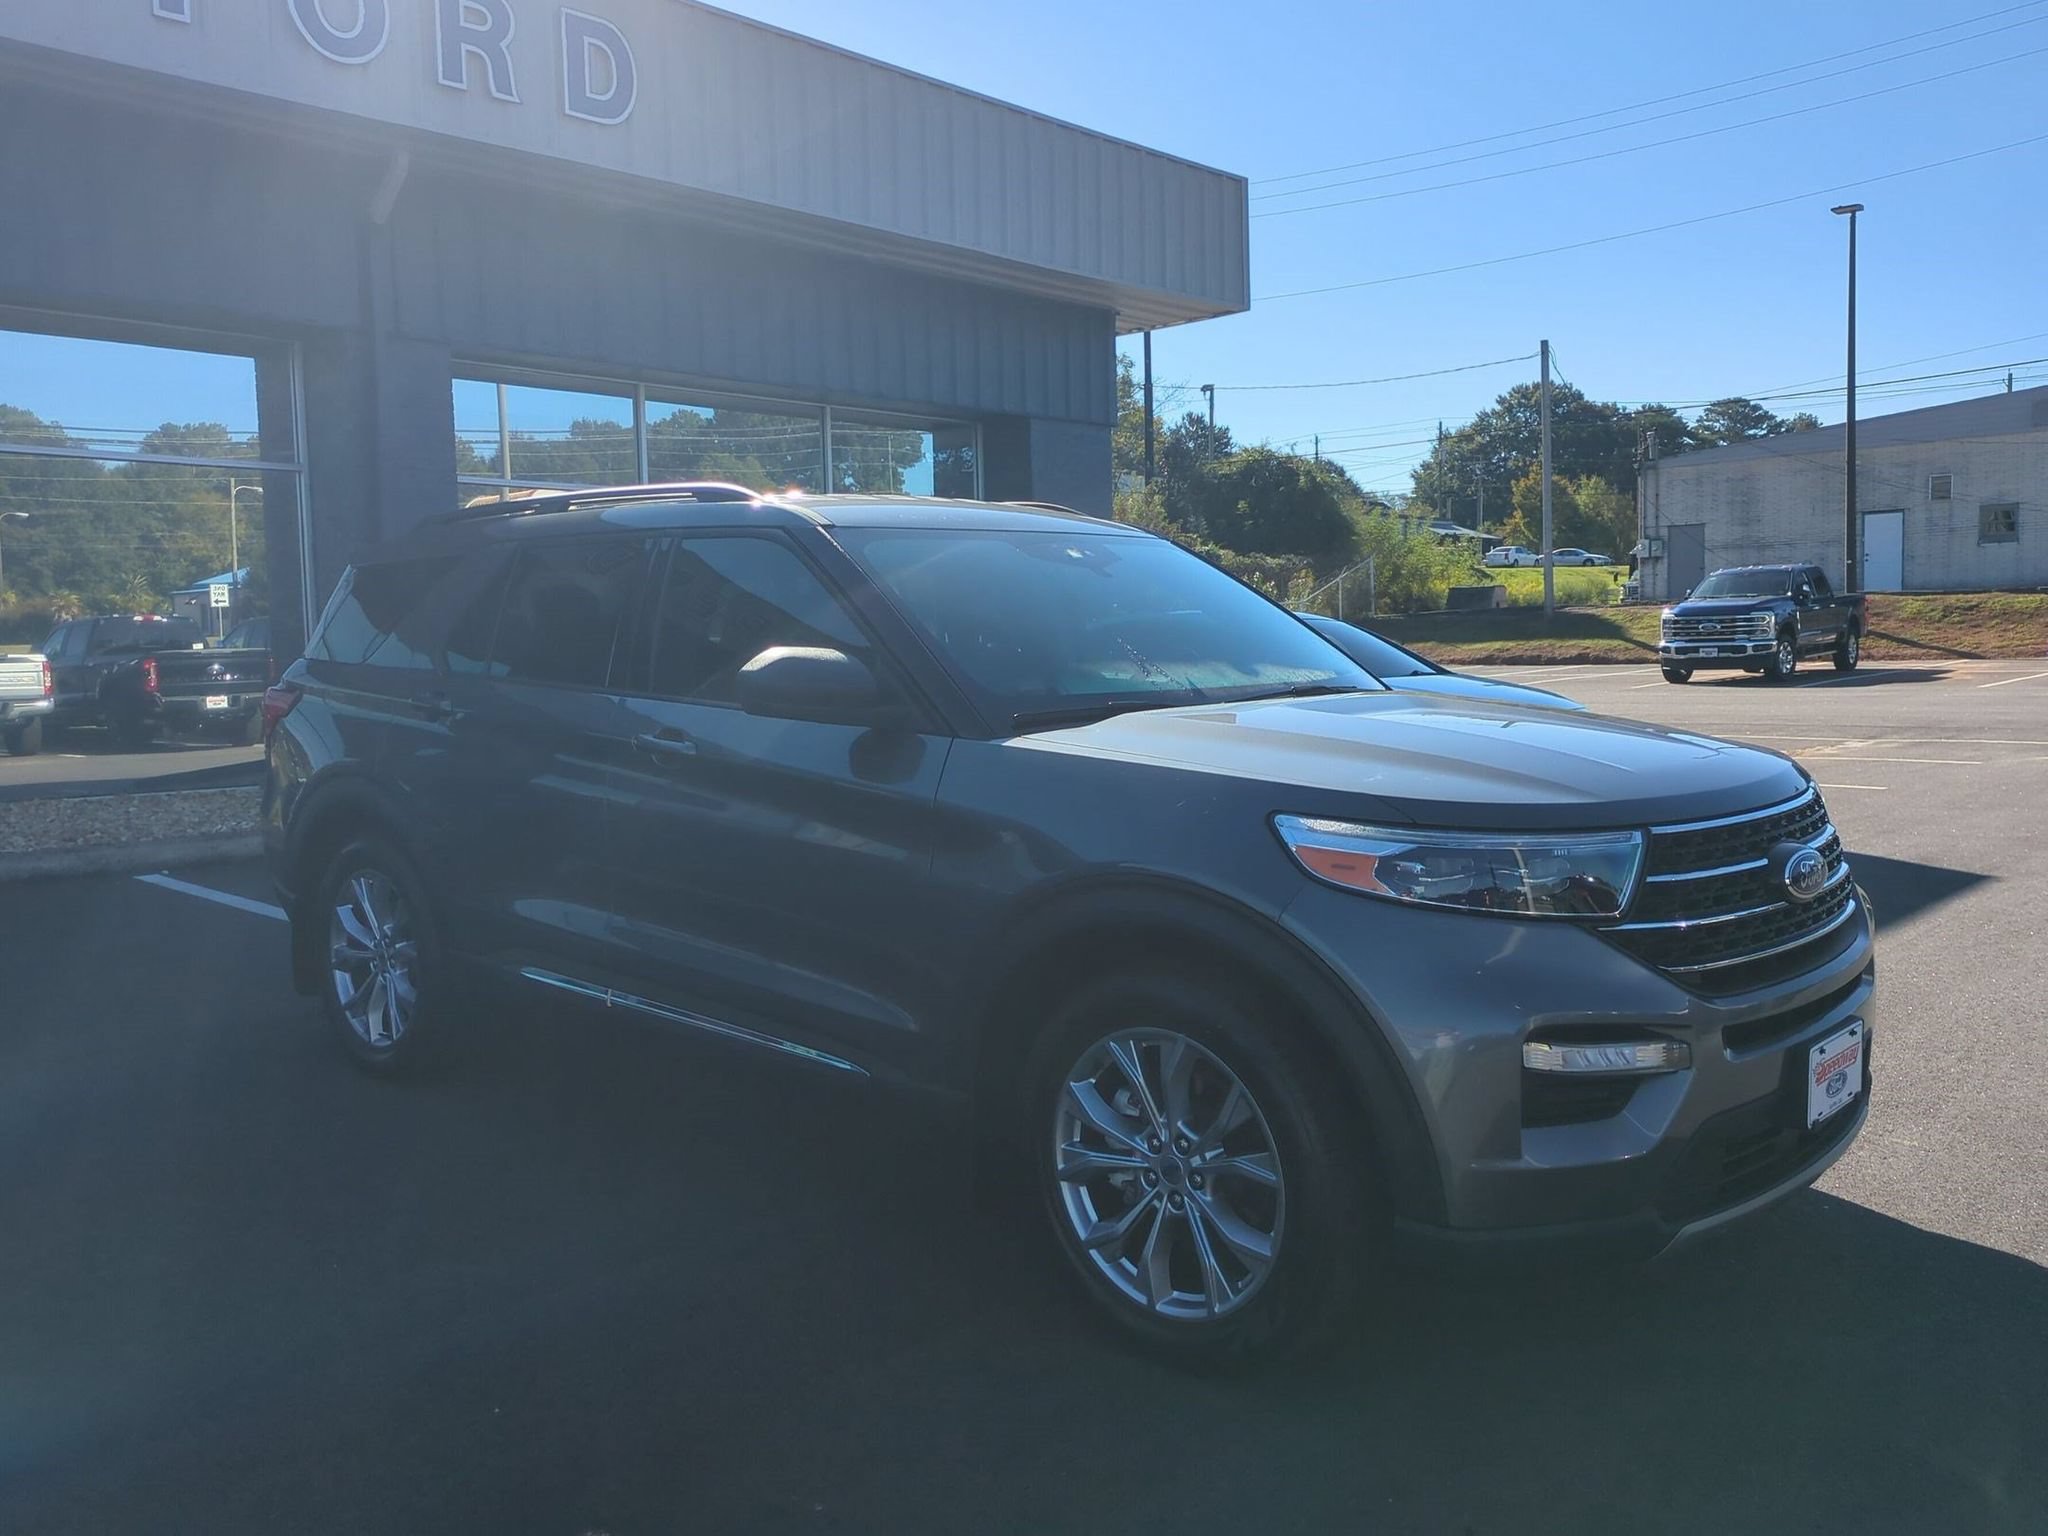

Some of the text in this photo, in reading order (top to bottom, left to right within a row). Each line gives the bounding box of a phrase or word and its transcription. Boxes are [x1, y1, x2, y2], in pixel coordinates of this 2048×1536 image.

[152, 0, 638, 125] ORD
[1800, 860, 1822, 888] Ford
[1814, 1044, 1861, 1085] Speedway
